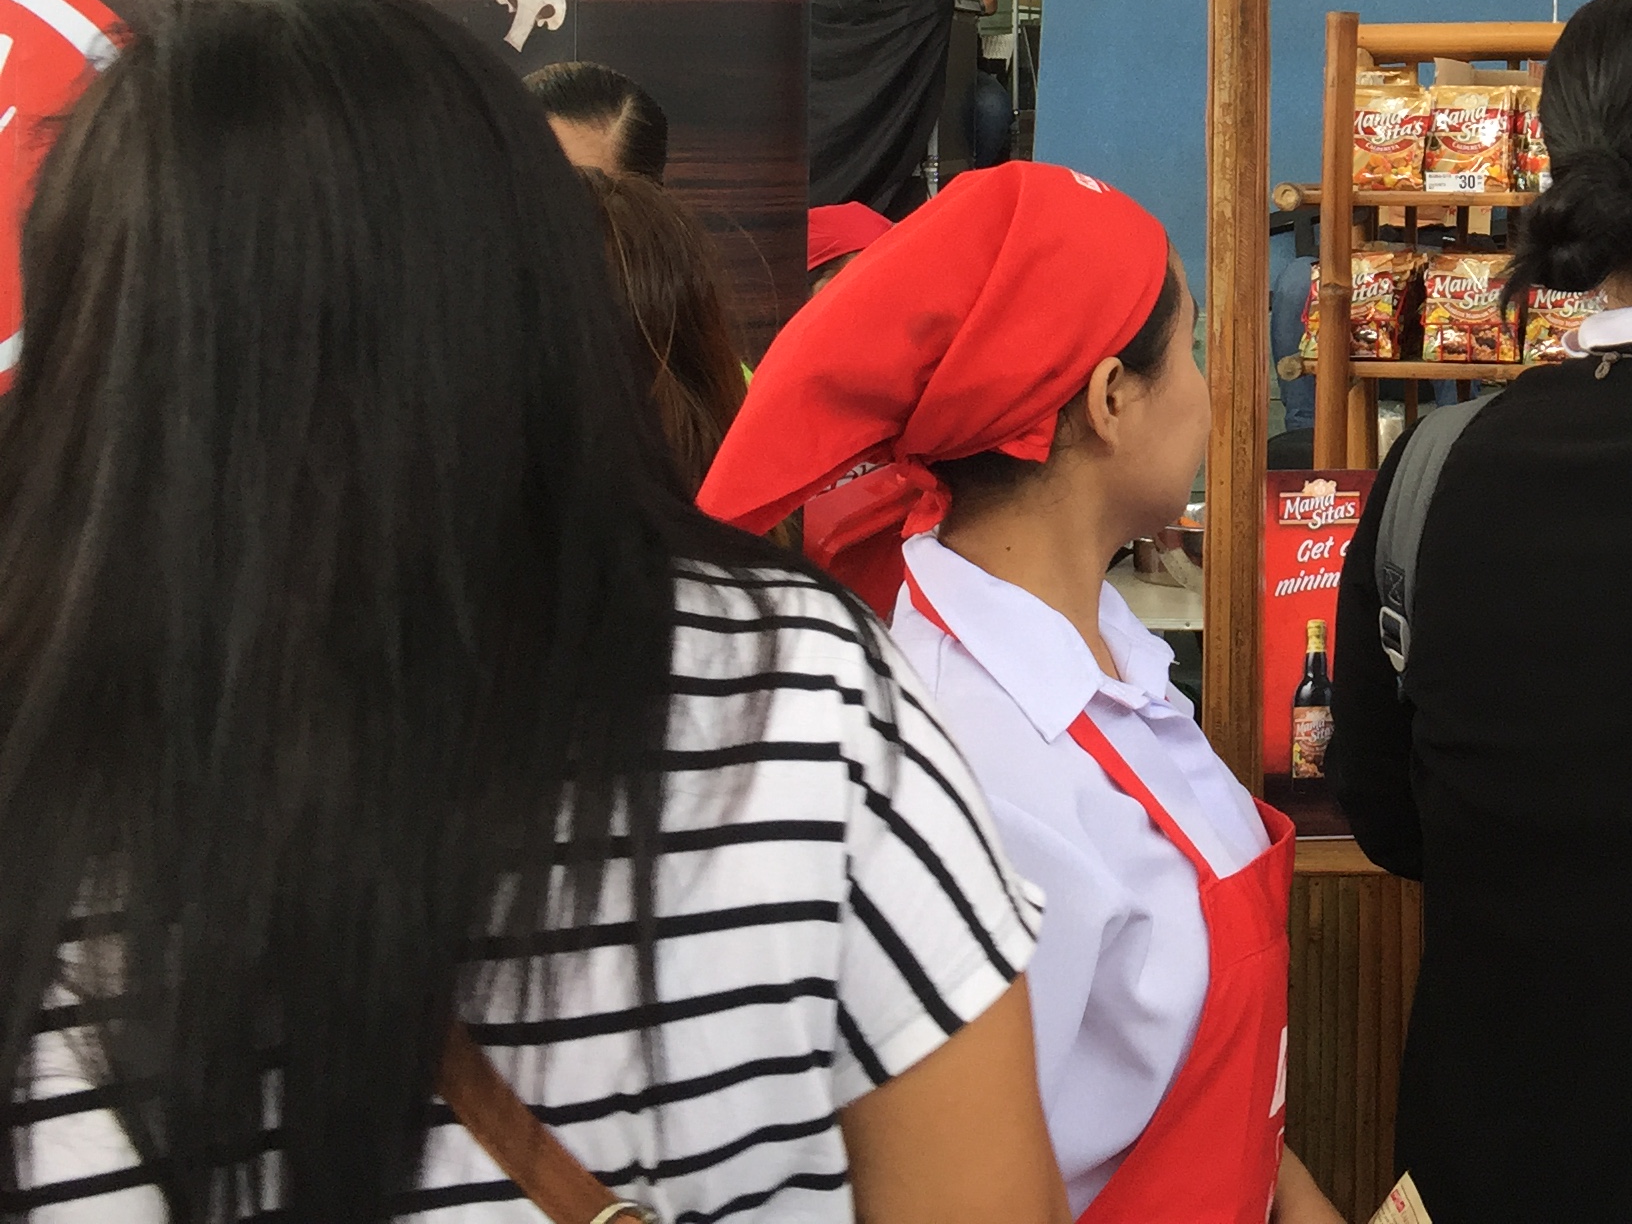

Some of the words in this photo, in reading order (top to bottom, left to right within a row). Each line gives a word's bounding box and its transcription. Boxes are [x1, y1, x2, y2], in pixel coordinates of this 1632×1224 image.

[1371, 117, 1424, 145] Sita's
[1459, 174, 1475, 189] 30
[1283, 493, 1336, 519] Mama
[1308, 501, 1356, 530] Sita's
[1297, 536, 1335, 563] Get
